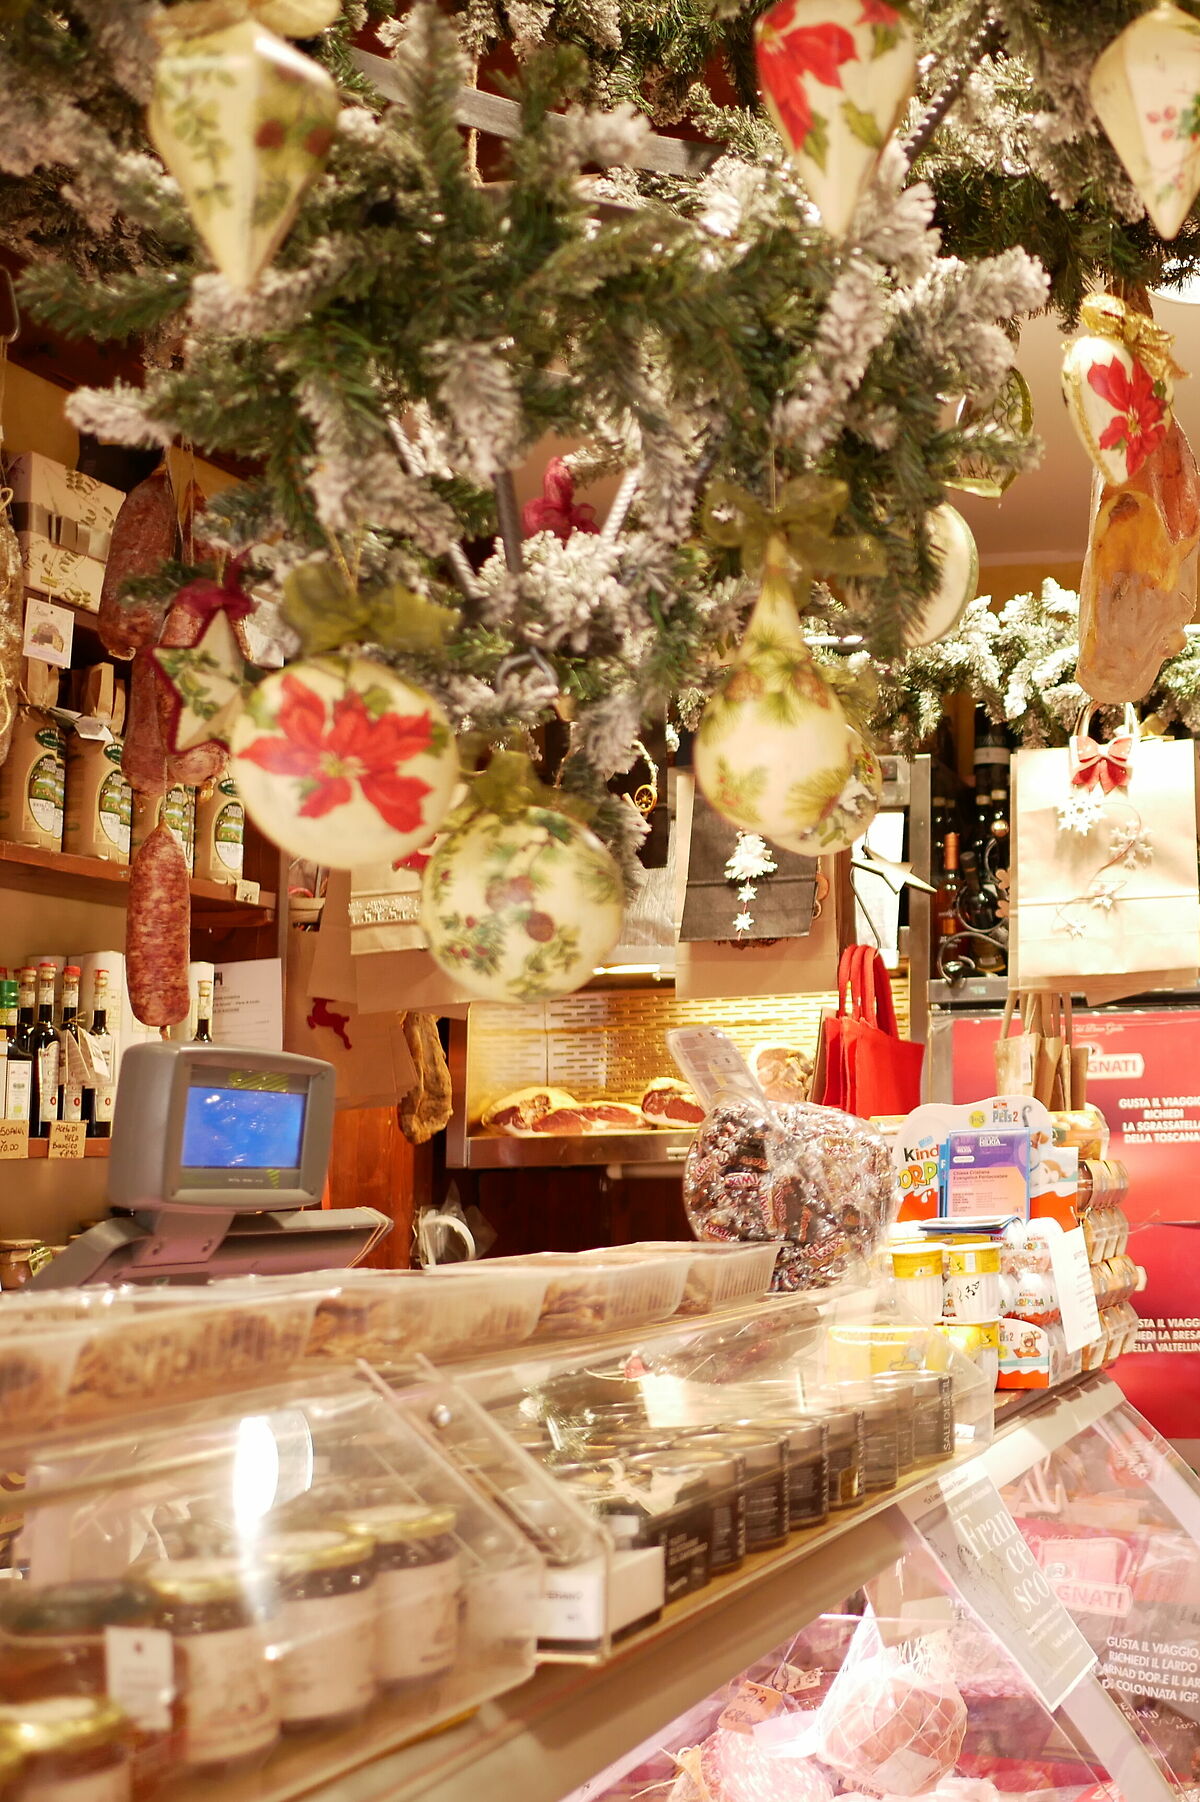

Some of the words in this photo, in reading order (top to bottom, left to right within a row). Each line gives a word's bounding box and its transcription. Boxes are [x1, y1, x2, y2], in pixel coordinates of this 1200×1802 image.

[1119, 1098, 1150, 1109] GUSTA
[1152, 1097, 1161, 1108] IL
[1143, 1109, 1184, 1119] RICHIEDI
[1123, 1122, 1136, 1132] LA
[1124, 1133, 1153, 1144] DELLA
[904, 1144, 940, 1163] Kind
[1138, 1318, 1155, 1328] STA
[1156, 1318, 1166, 1328] IL
[1158, 1330, 1171, 1340] LA
[1133, 1342, 1154, 1352] ELLA
[943, 1423, 953, 1451] SALE
[955, 1509, 1017, 1562] Fran
[1005, 1543, 1029, 1575] ce
[1012, 1570, 1051, 1614] sco
[1106, 1637, 1140, 1652] GUSTA
[1141, 1641, 1151, 1652] IL
[1108, 1651, 1150, 1667] RICHIEDI
[1151, 1658, 1160, 1670] IL
[1161, 1659, 1198, 1673] LARDO
[1171, 1675, 1181, 1686] IL
[1115, 1680, 1178, 1701] COLONNATA
